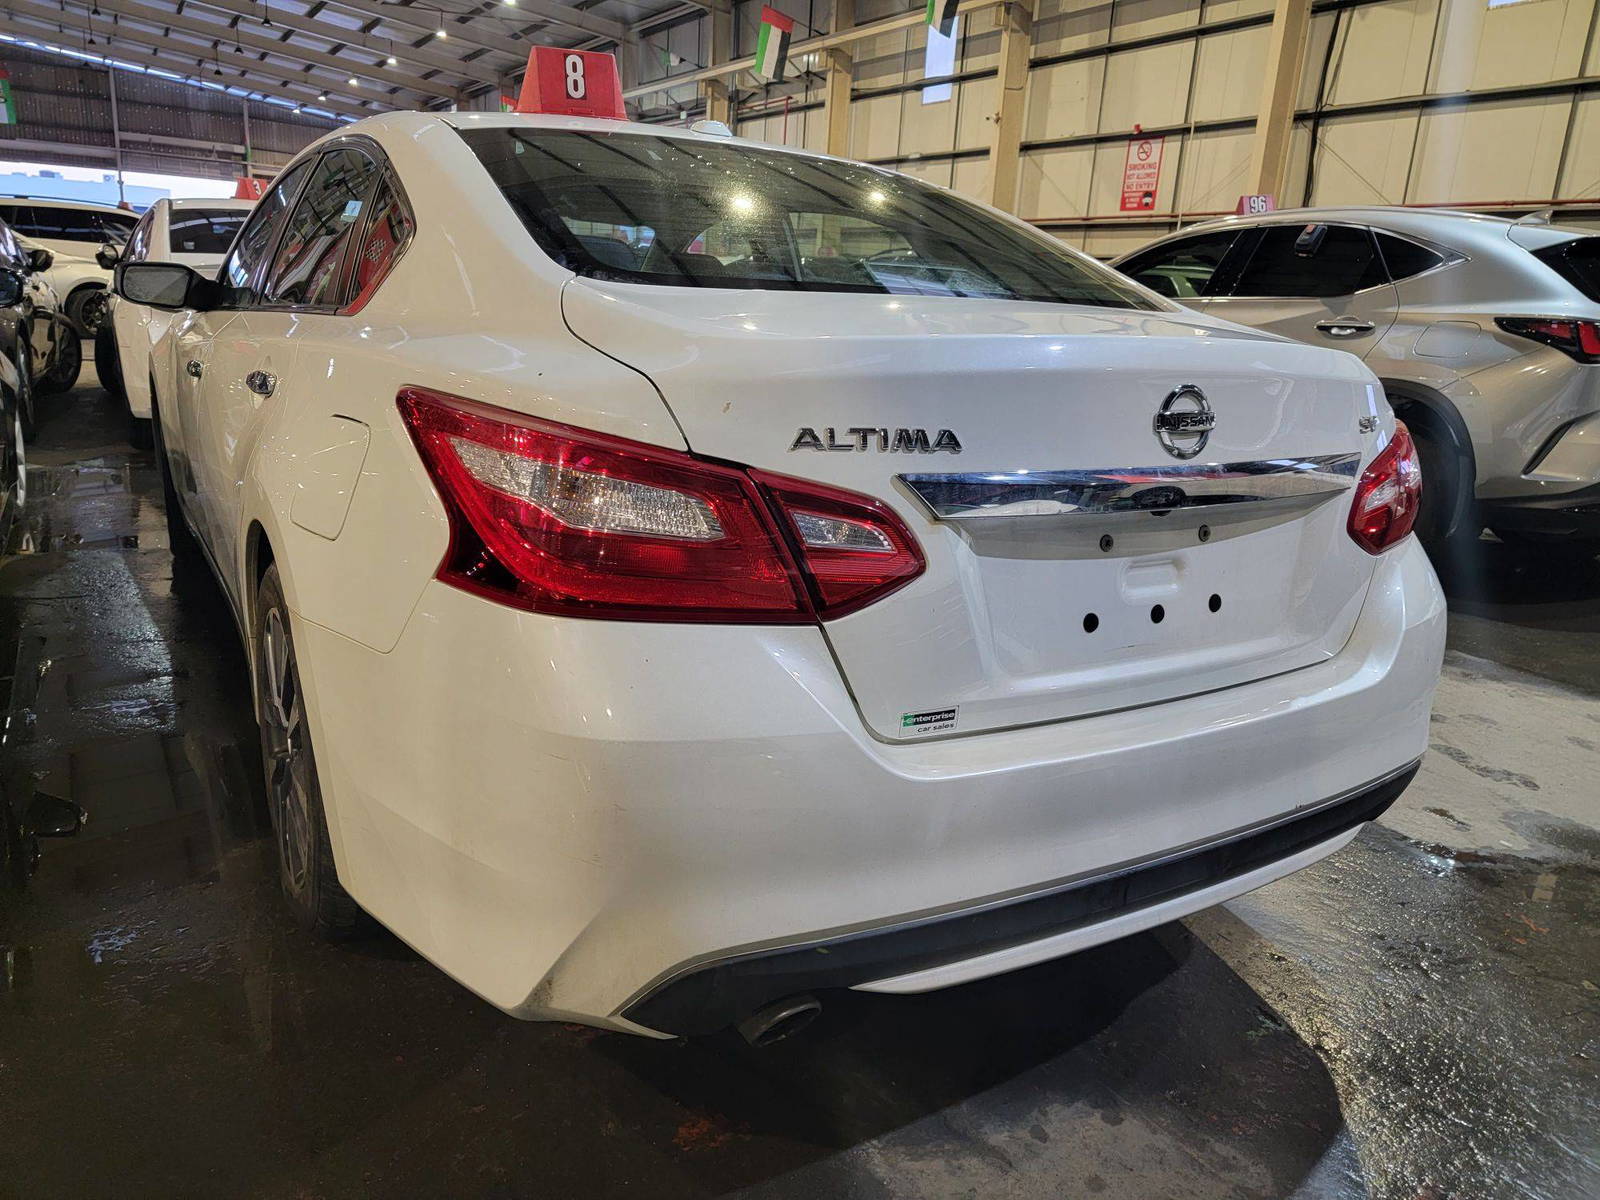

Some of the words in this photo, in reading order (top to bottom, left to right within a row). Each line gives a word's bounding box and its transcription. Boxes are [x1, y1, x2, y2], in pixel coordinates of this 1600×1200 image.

[565, 54, 585, 99] 8
[1136, 182, 1154, 190] ENTRY
[1250, 196, 1267, 213] 96
[1166, 414, 1213, 430] NISSAN
[788, 427, 963, 454] ALTIMA
